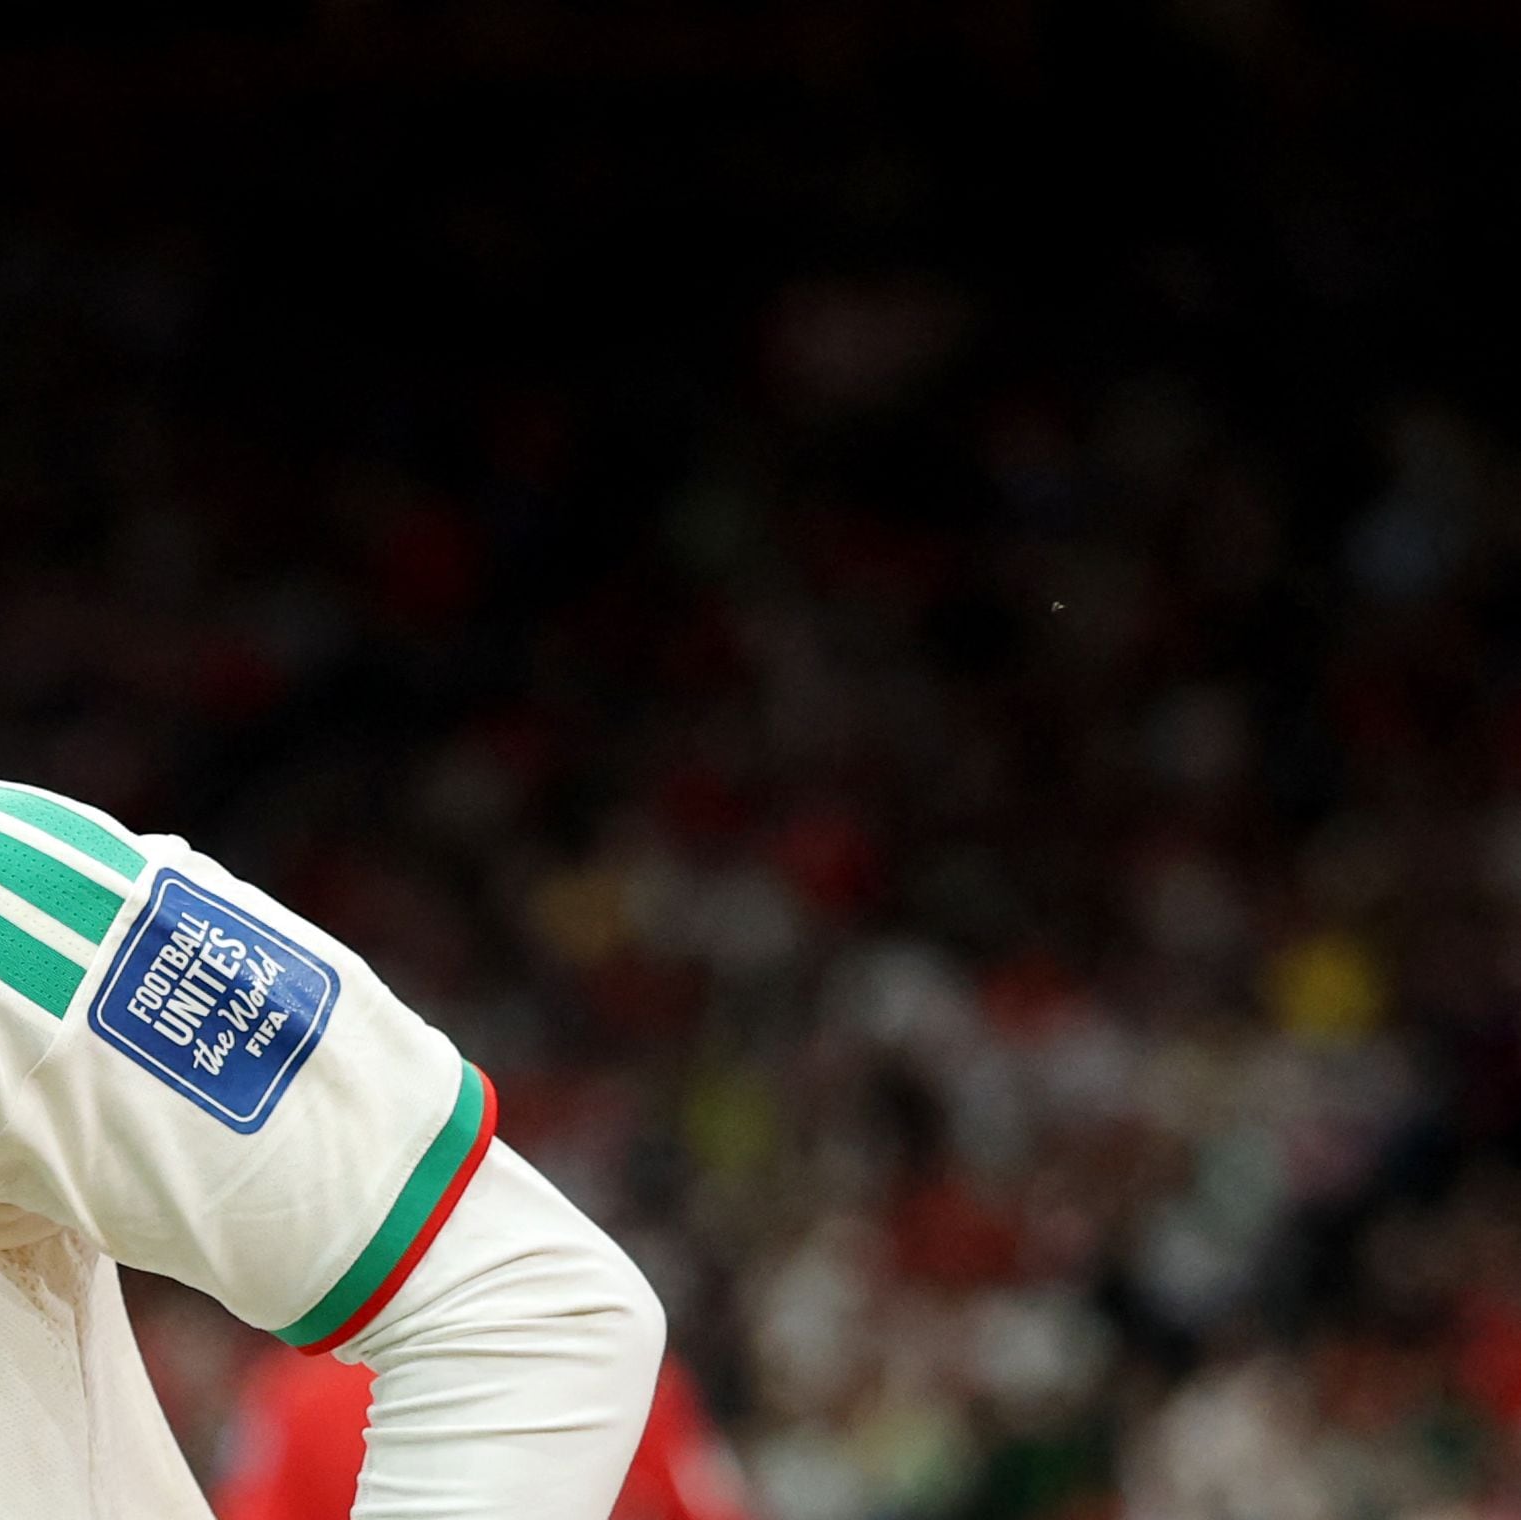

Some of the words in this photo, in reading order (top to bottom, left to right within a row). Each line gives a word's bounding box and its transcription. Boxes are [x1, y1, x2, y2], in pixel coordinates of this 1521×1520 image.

[127, 912, 210, 1024] FOOTBALL
[153, 927, 247, 1046] UNITES
[193, 1030, 235, 1076] the
[218, 945, 286, 1031] World
[245, 1011, 289, 1057] FIFA
